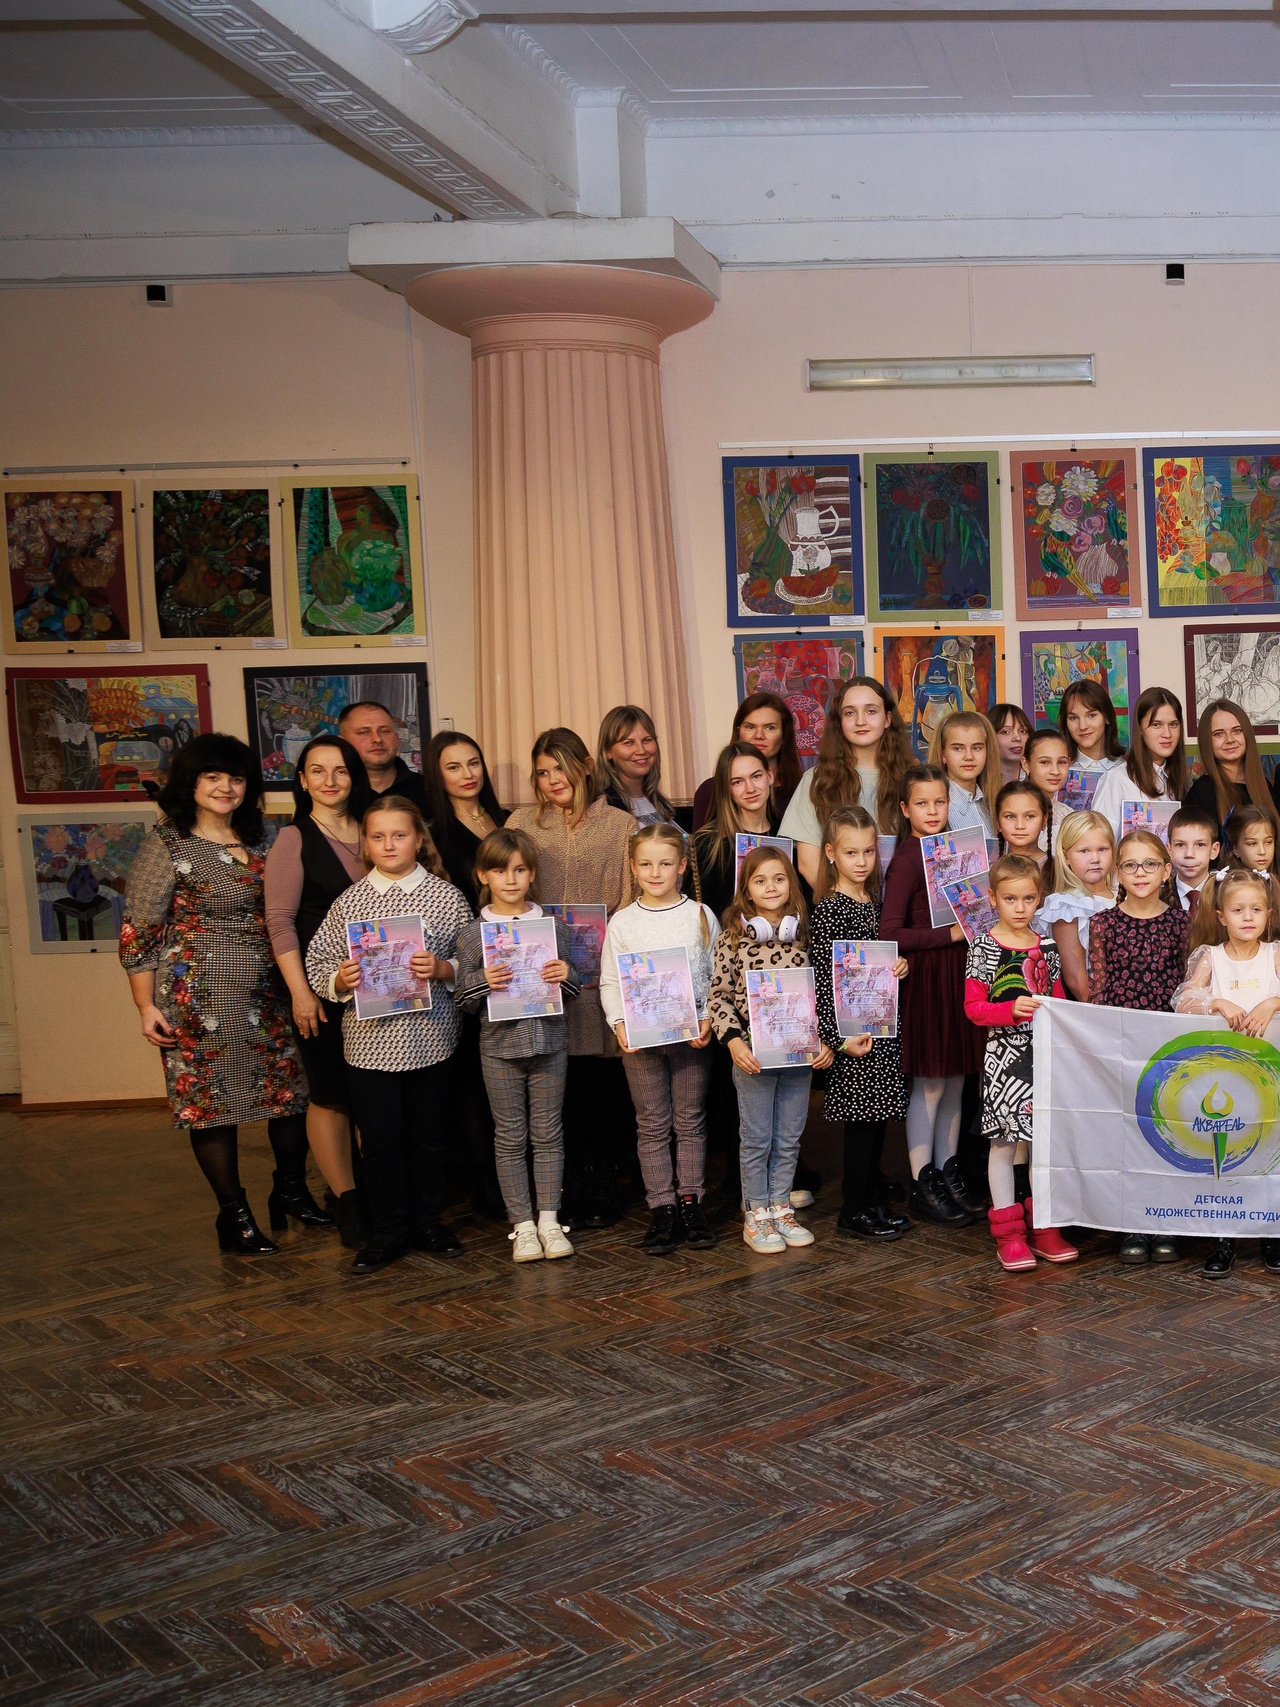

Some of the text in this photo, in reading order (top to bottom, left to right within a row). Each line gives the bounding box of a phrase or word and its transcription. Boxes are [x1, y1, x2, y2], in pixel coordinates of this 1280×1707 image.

[1192, 1116, 1246, 1132] АКВАРЕЛЬ
[1194, 1194, 1243, 1205] ДЕТСКАЯ
[1145, 1207, 1246, 1219] ХУДОЖЕСТВЕННАЯ
